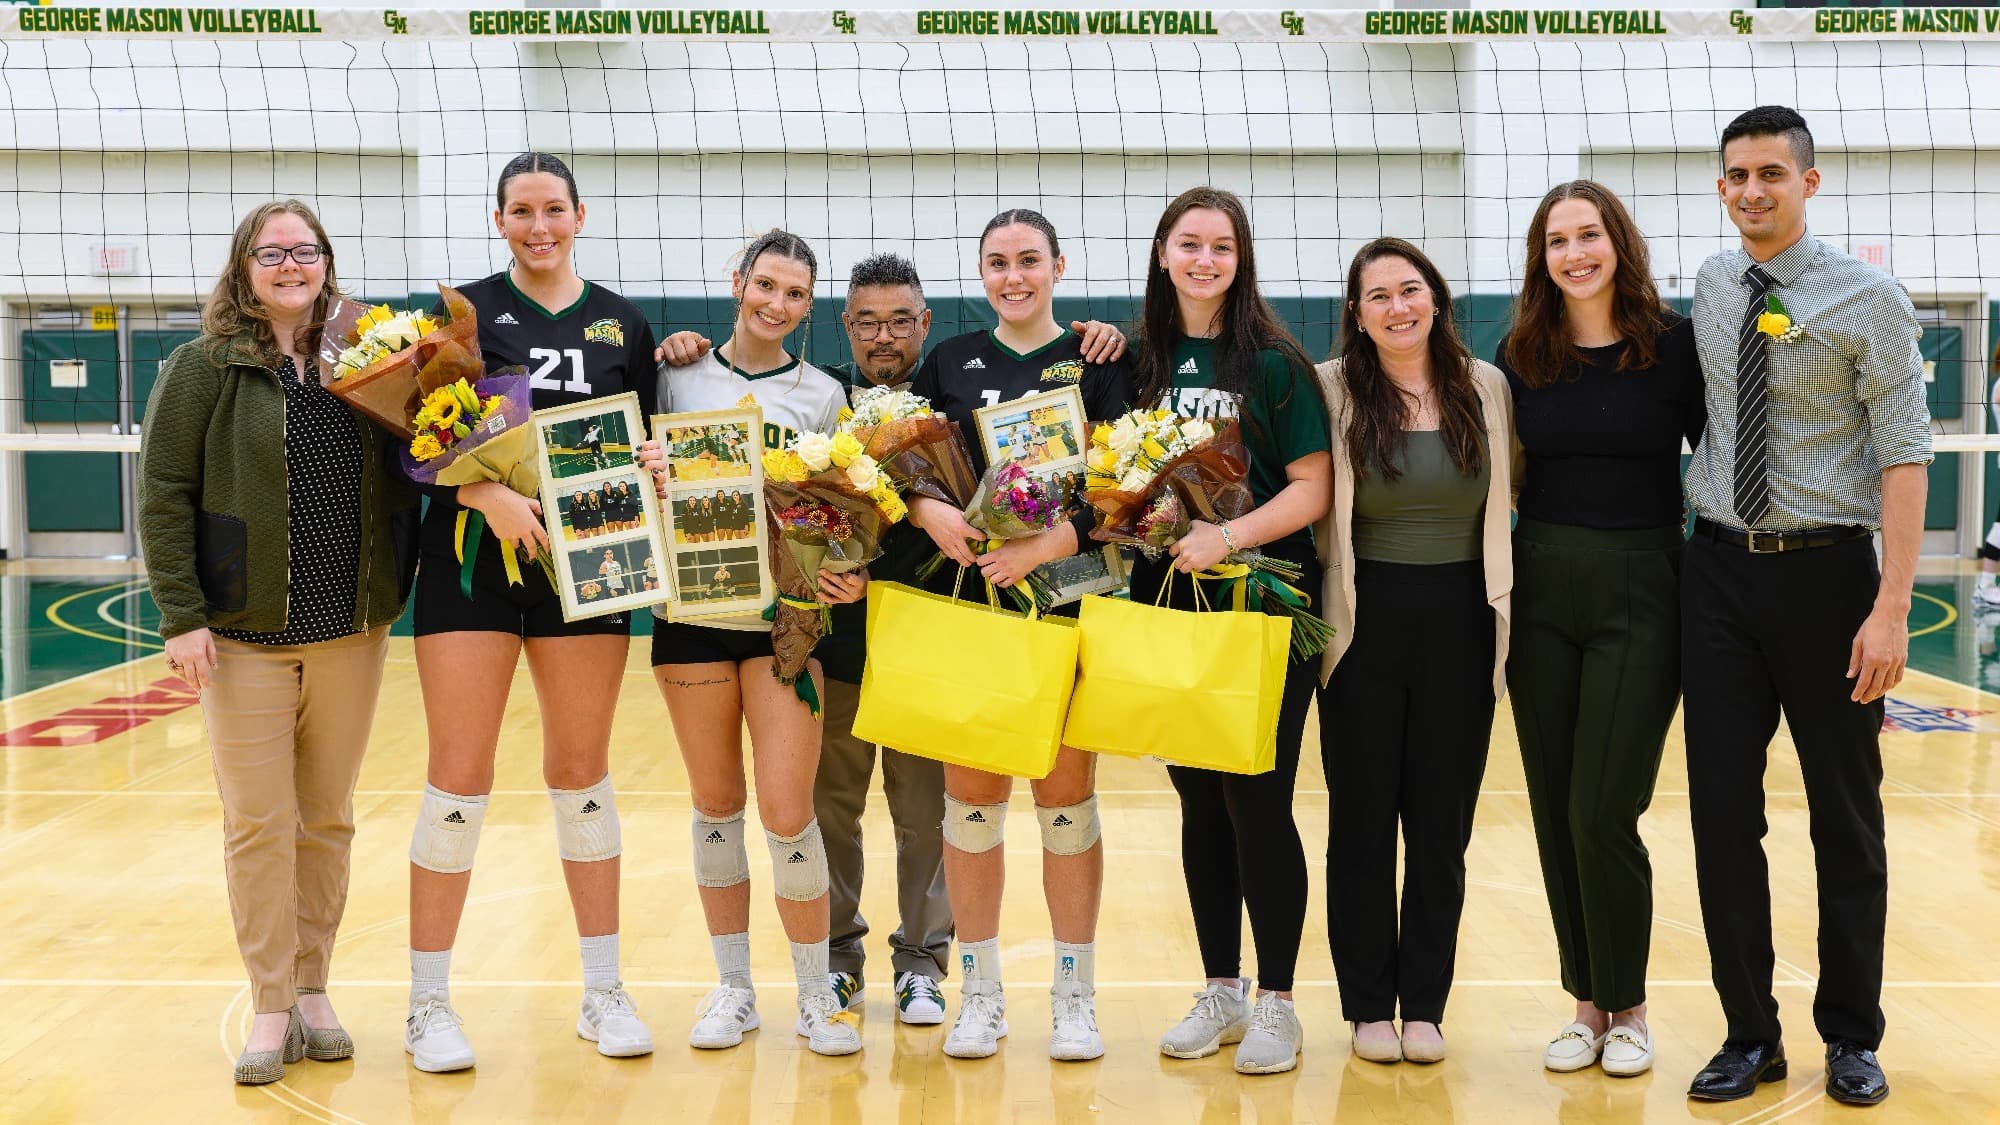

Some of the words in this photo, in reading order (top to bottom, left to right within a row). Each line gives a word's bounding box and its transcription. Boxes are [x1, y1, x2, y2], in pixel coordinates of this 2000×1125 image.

[18, 7, 102, 32] GEORGE
[105, 7, 183, 33] MASON
[187, 8, 322, 33] VOLLEYBALL
[469, 10, 551, 35] GEORGE
[555, 10, 632, 34] MASON
[636, 10, 770, 34] VOLLEYBALL
[917, 10, 1000, 35] GEORGE
[1004, 10, 1081, 35] MASON
[1085, 10, 1218, 35] VOLLEYBALL
[1365, 10, 1448, 35] GEORGE
[1452, 10, 1529, 35] MASON
[1533, 10, 1665, 35] VOLLEYBALL
[1815, 9, 1897, 33] GEORGE
[1902, 8, 1979, 33] MASON
[583, 324, 624, 347] MASON
[529, 347, 592, 394] 21
